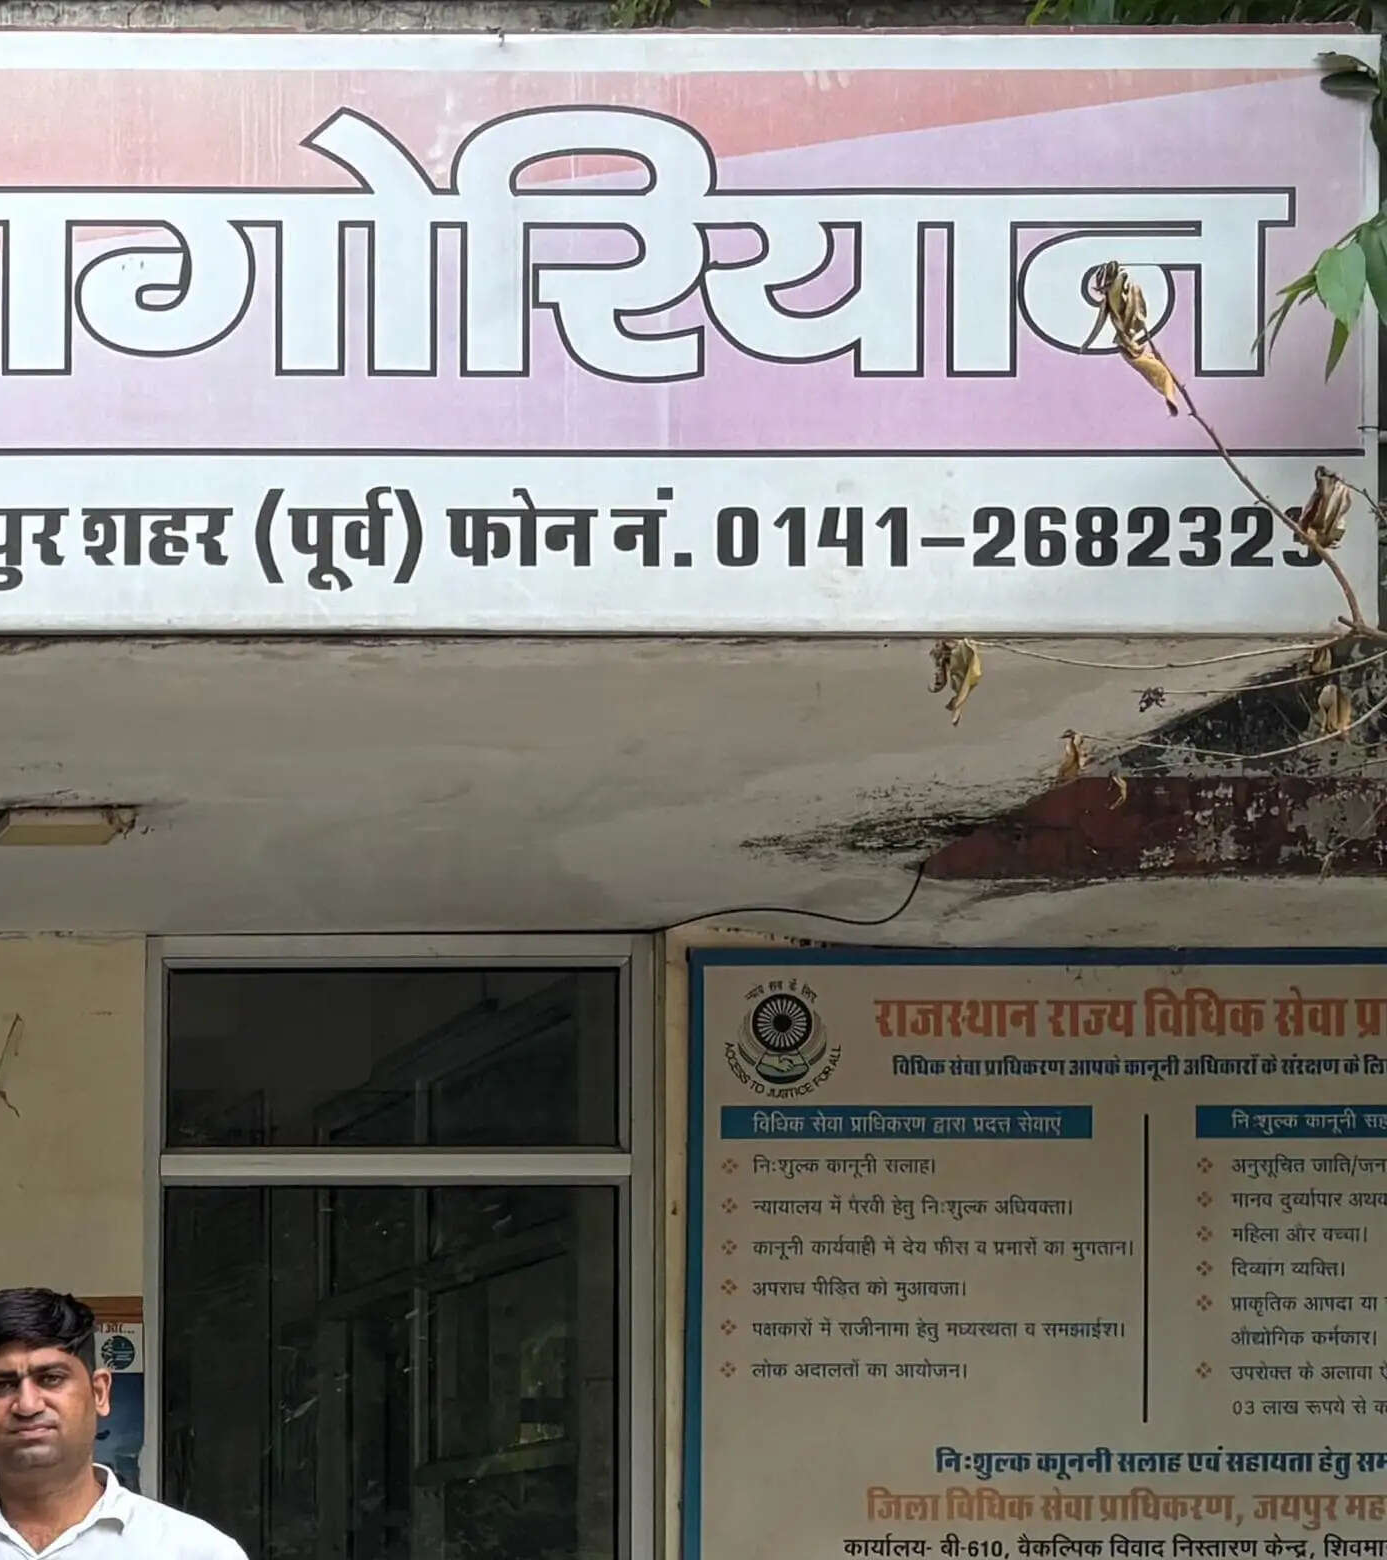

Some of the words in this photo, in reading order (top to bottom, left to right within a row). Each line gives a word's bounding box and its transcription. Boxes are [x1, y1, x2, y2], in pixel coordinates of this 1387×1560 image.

[83, 505, 235, 567] शहर
[253, 486, 422, 592] (पूर्व)
[446, 487, 598, 565] फोन
[610, 486, 693, 567] नं.
[874, 999, 1039, 1037] राजस्थान
[1047, 999, 1137, 1037] राज्य
[1144, 987, 1266, 1037] विधिक
[1274, 985, 1348, 1037] सेवा
[893, 1055, 945, 1076] विधिक
[949, 1054, 981, 1076] सेवा
[984, 1055, 1064, 1077] प्राधिकरण
[1069, 1054, 1121, 1076] आपके
[1125, 1054, 1179, 1082] कानूनी
[1184, 1054, 1258, 1076] अधिकारों
[1262, 1054, 1277, 1075] के
[1281, 1053, 1339, 1075] संरक्षण
[1344, 1054, 1361, 1075] के
[750, 1080, 765, 1094] TO
[766, 1082, 813, 1099] JUSTICE
[814, 1065, 833, 1087] FOR
[754, 1111, 804, 1133] विधिक
[810, 1111, 842, 1133] सेवा
[850, 1111, 925, 1133] प्राधिकरण
[932, 1115, 965, 1134] द्वारा
[973, 1116, 1011, 1133] प्रदत्त
[1019, 1110, 1063, 1134] सेवाएं
[1305, 1109, 1356, 1134] कानूनी
[754, 1154, 818, 1180] निःशुल्क
[826, 1154, 876, 1178] कानूनी
[1231, 1153, 1305, 1179] अनुसूचित
[753, 1200, 821, 1215] न्यायालय
[830, 1194, 842, 1214] में
[892, 1195, 914, 1219] हेतु
[922, 1195, 988, 1220] निःशुल्क
[1231, 1192, 1272, 1208] मानव
[1231, 1223, 1279, 1243] महिला
[1286, 1223, 1316, 1242] और
[753, 1235, 803, 1260] कानूनी
[811, 1234, 875, 1256] कार्यवाही
[903, 1236, 927, 1255] देय
[934, 1236, 969, 1255] फीस
[976, 1241, 986, 1255] व
[1043, 1241, 1065, 1255] का
[1231, 1257, 1284, 1277] दिव्यांग
[753, 1282, 804, 1296] अपराध
[812, 1275, 859, 1299] पीड़ित
[867, 1276, 888, 1296] को
[1231, 1292, 1297, 1316] प्राकृतिक
[1304, 1297, 1353, 1311] आपदा
[1360, 1297, 1378, 1311] या
[753, 1317, 812, 1337] पक्षकारों
[819, 1317, 831, 1336] में
[838, 1316, 909, 1337] राजीनामा
[916, 1318, 939, 1342] हेतु
[945, 1322, 1017, 1336] मध्यस्थता
[1024, 1322, 1036, 1336] व
[1231, 1325, 1305, 1346] औद्योगिक
[751, 1358, 788, 1378] लोक
[794, 1358, 860, 1379] अदालतों
[866, 1363, 887, 1379] का
[1230, 1361, 1291, 1380] उपरोक्त
[1299, 1361, 1314, 1380] के
[1321, 1365, 1372, 1380] अलावा
[1232, 1400, 1255, 1415] 03
[1261, 1400, 1299, 1415] लाख
[1305, 1395, 1345, 1415] रूपये
[1352, 1395, 1366, 1415] से
[935, 1447, 1032, 1479] निःशुल्क
[1118, 1452, 1183, 1473] सलाह
[1188, 1446, 1223, 1473] एवं
[1225, 1452, 1313, 1473] सहायता
[1318, 1446, 1351, 1479] हेतु
[867, 1486, 940, 1522] जिला
[946, 1486, 1035, 1522] विधिक
[1040, 1486, 1094, 1522] सेवा
[1100, 1486, 1244, 1527] प्राधिकरण,
[1253, 1493, 1339, 1531] जयपुर
[1018, 1533, 1102, 1558] वैकल्पिक
[1110, 1533, 1165, 1558] विवाद
[1173, 1533, 1258, 1558] निस्तारण
